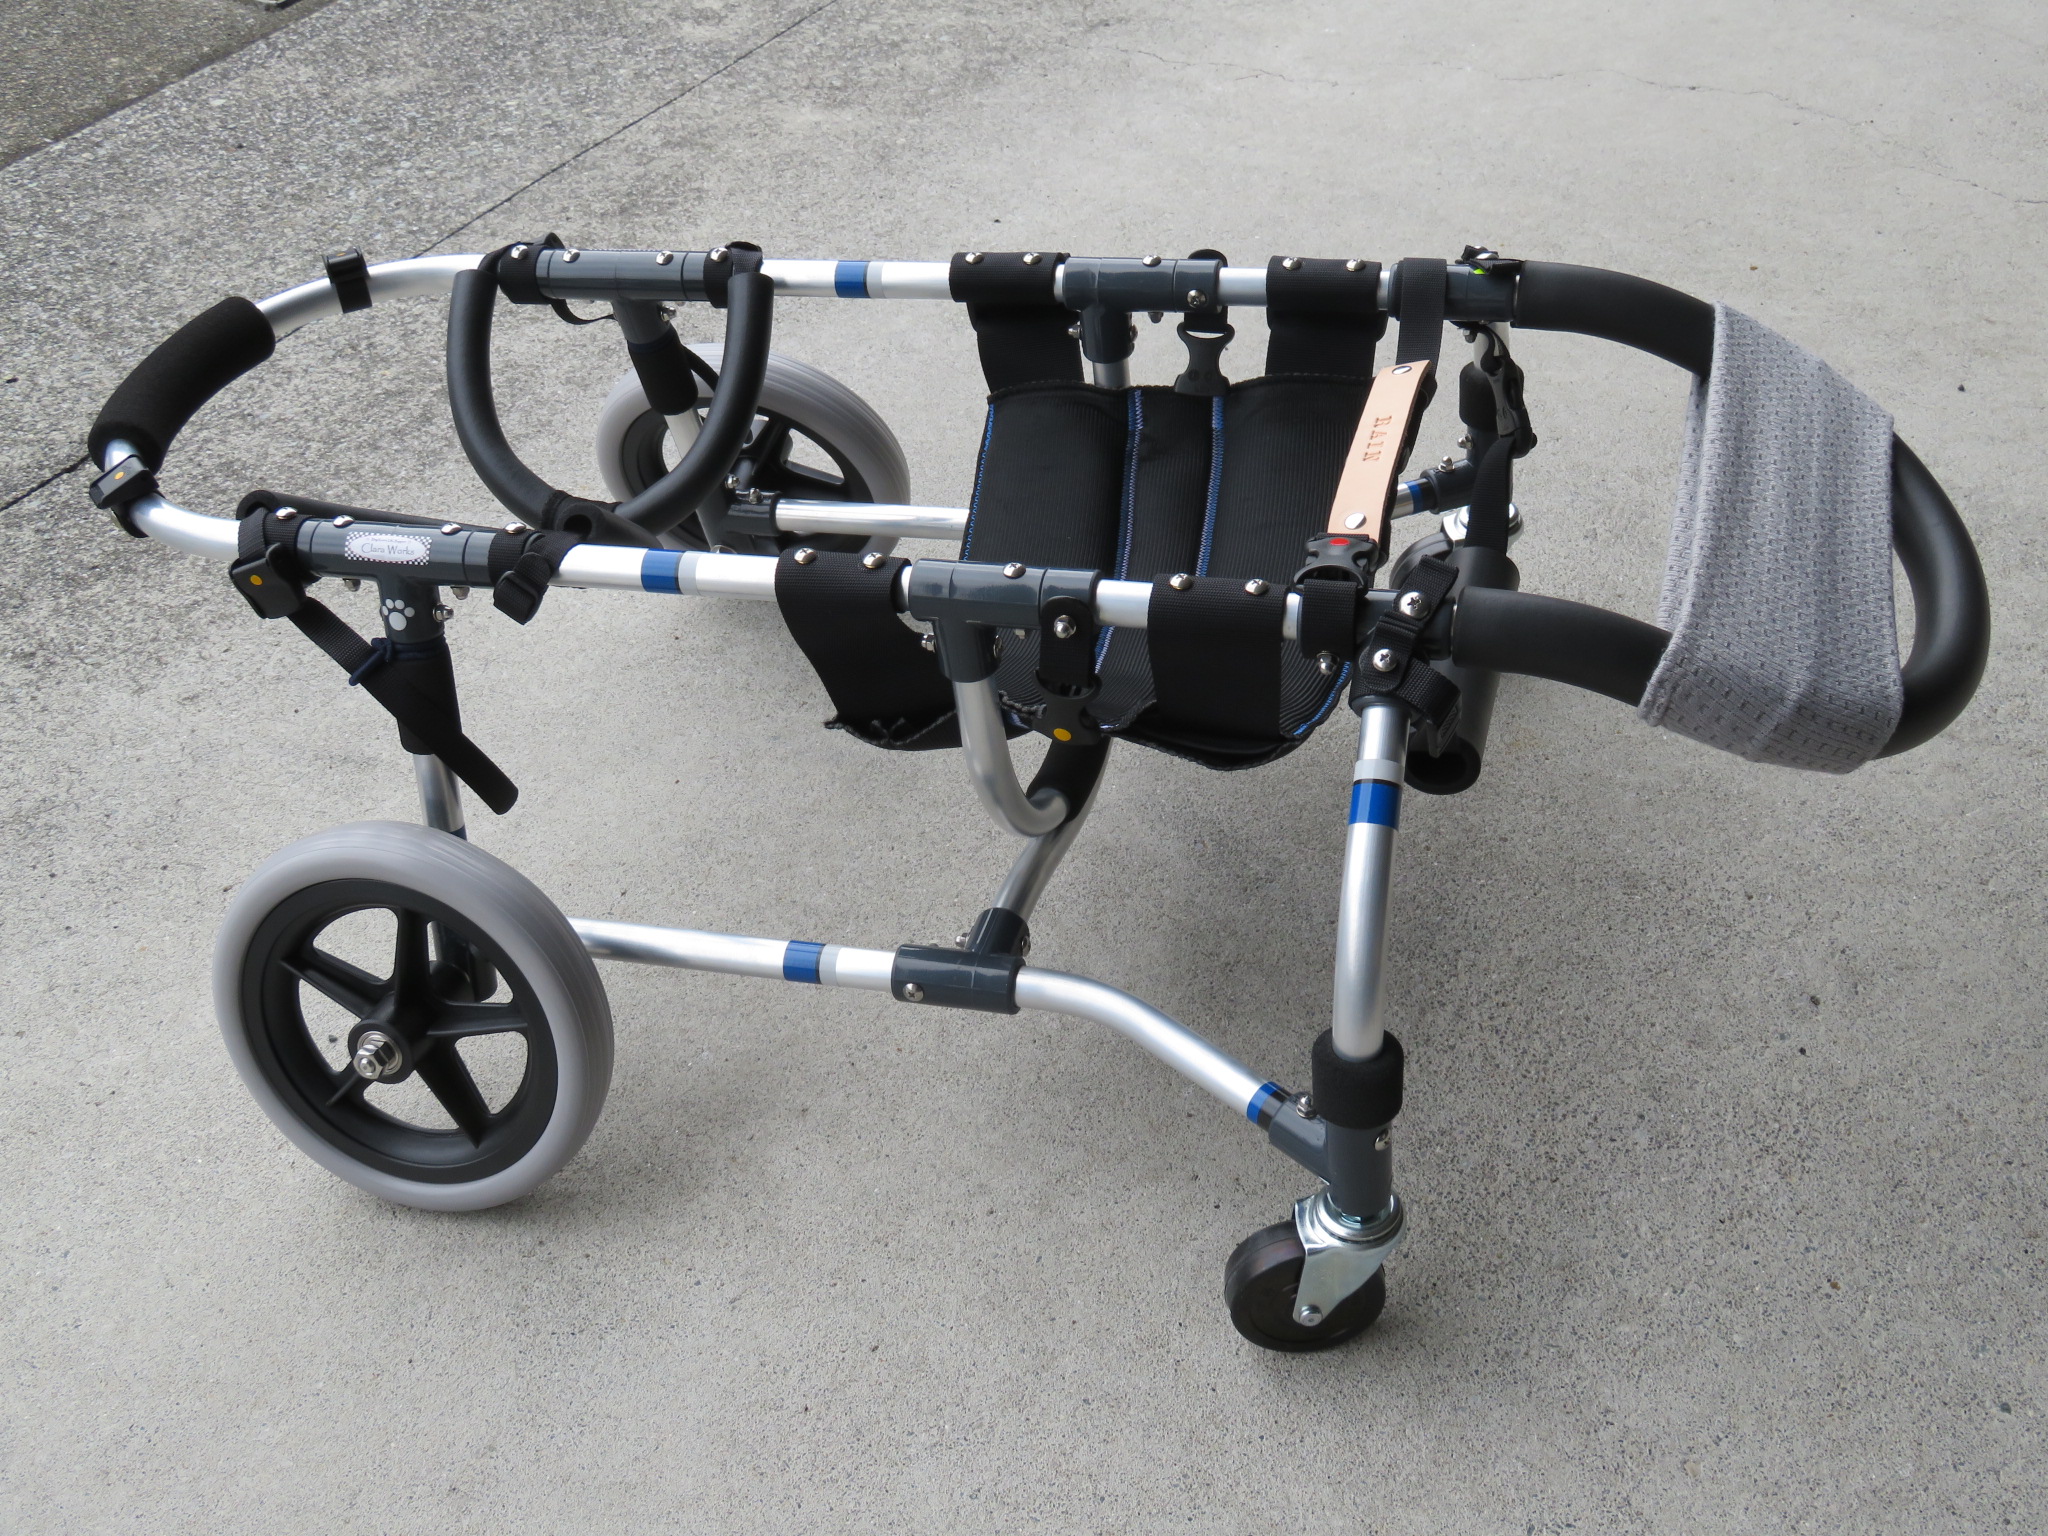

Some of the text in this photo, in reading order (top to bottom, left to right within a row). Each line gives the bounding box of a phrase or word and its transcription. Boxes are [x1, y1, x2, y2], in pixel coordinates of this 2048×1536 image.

[1362, 415, 1392, 461] RAIN
[361, 543, 415, 556] Clara Works
